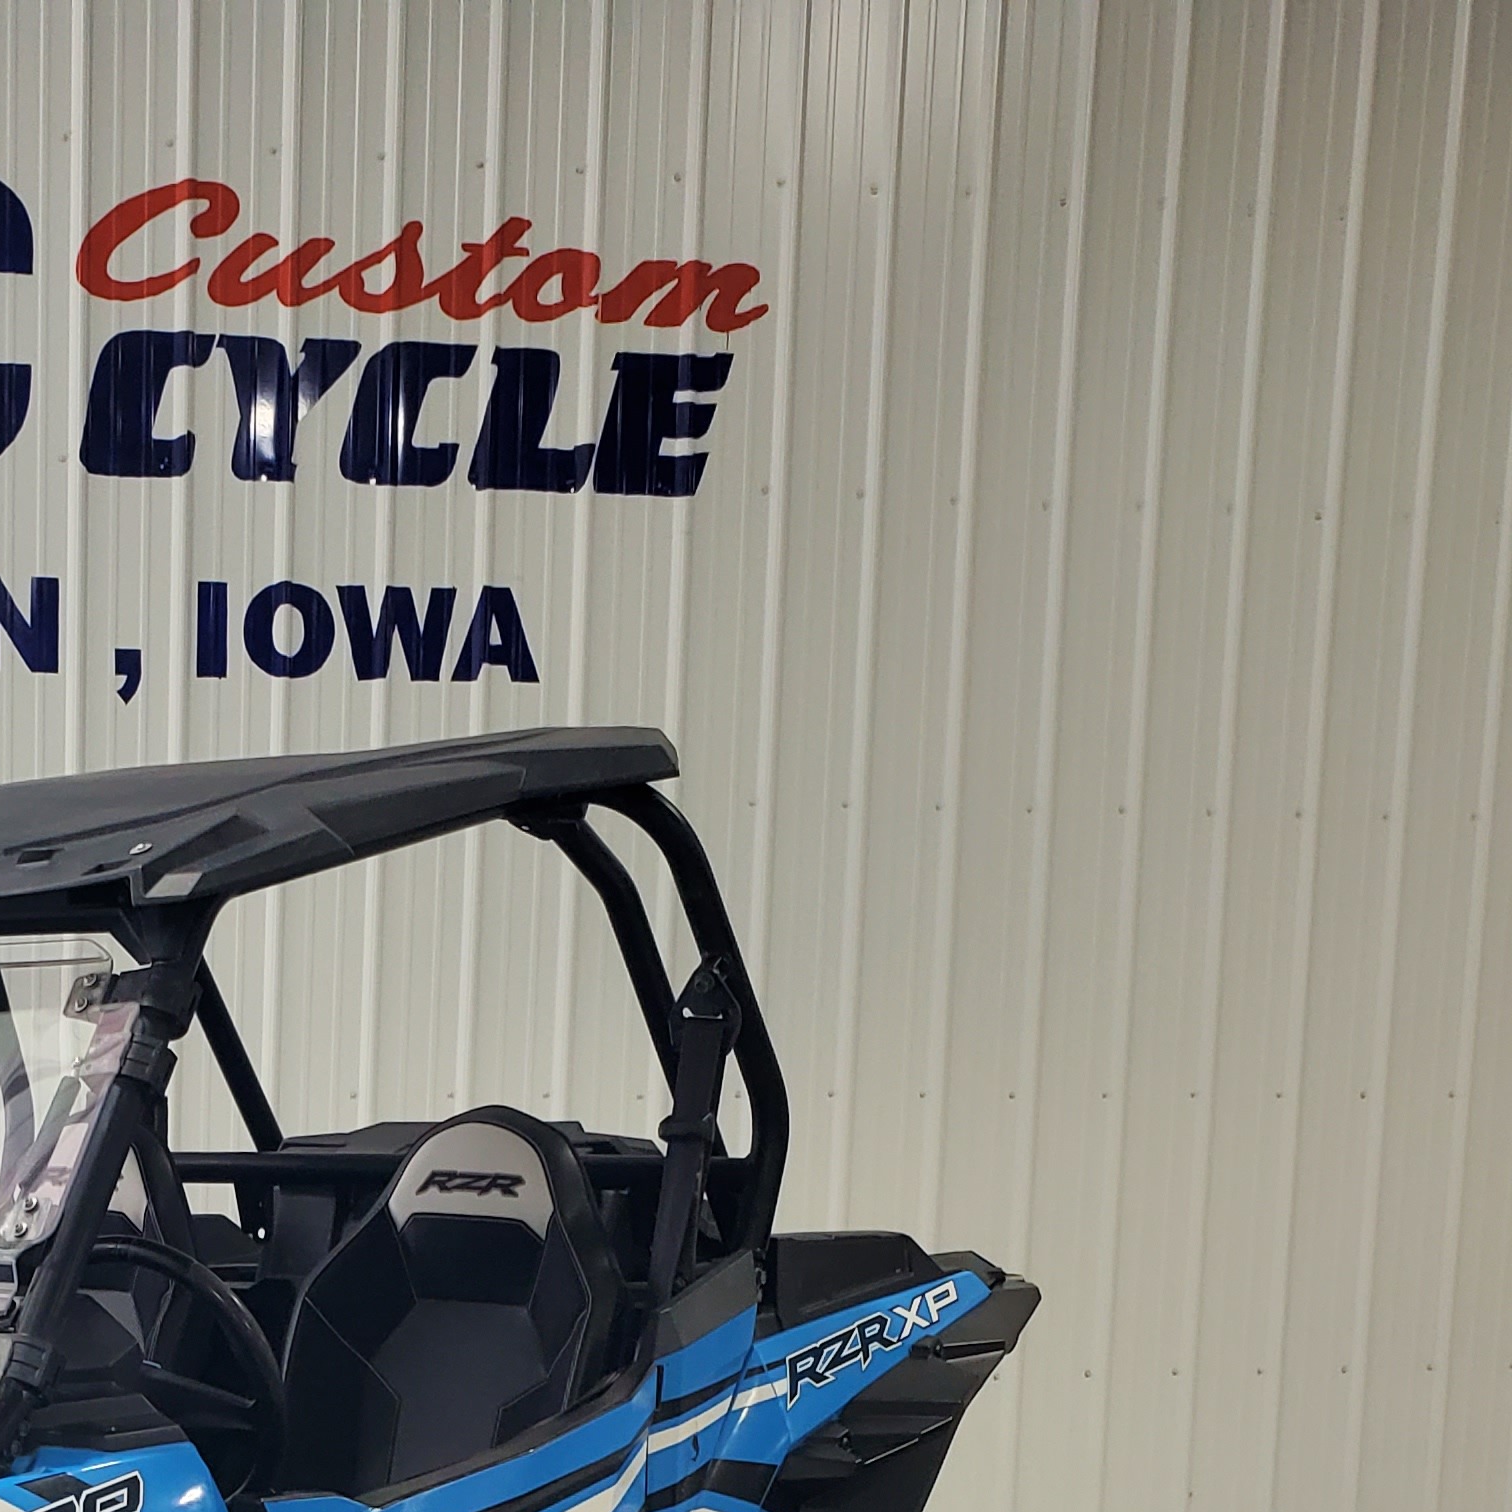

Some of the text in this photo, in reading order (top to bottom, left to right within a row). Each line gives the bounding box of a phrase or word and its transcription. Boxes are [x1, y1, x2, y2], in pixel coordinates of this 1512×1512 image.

[76, 178, 769, 333] Custom
[79, 330, 734, 497] CYCLE
[196, 580, 540, 683] IOWA
[416, 1170, 526, 1198] RZR
[786, 1280, 958, 1411] RZR XP
